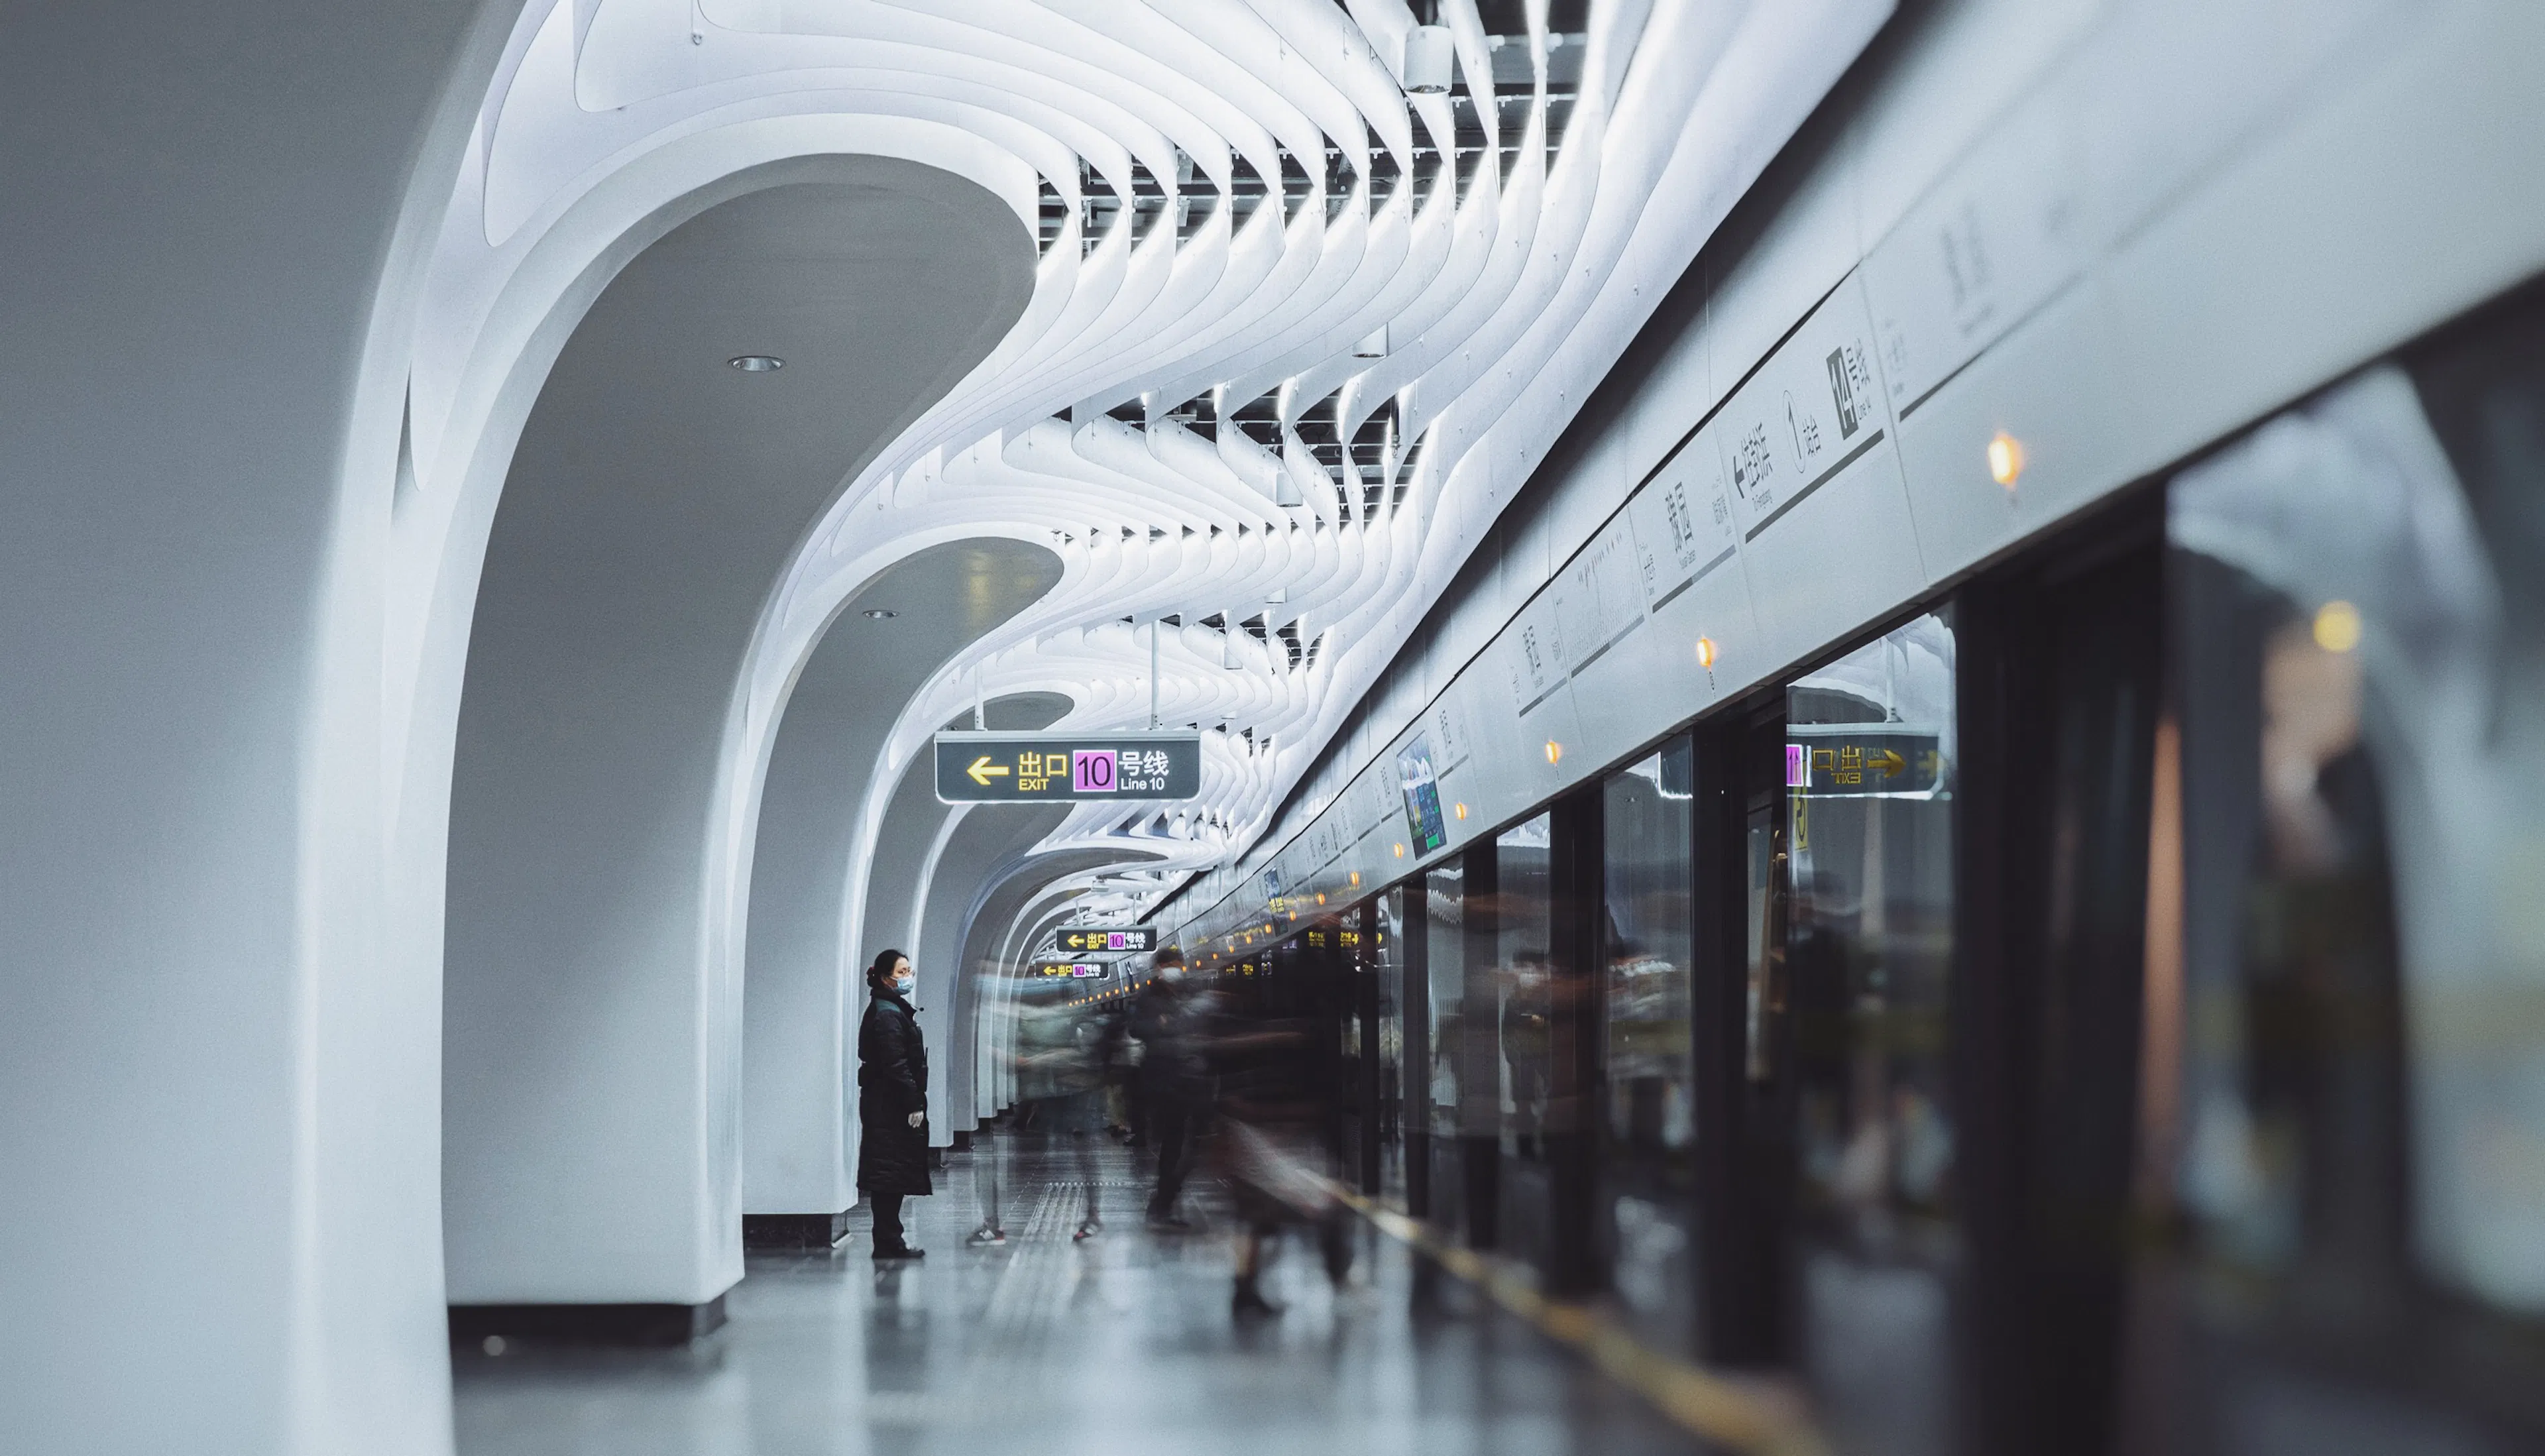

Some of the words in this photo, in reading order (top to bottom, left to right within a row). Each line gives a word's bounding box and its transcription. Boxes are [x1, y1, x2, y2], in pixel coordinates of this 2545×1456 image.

[1831, 357, 1854, 429] 14
[1788, 400, 1801, 460] 1
[1018, 751, 1068, 777] 出口
[1078, 756, 1111, 787] 10
[1118, 750, 1170, 777] 号线
[1018, 778, 1049, 791] EXIT
[1121, 778, 1147, 791] Line
[1149, 777, 1165, 791] 10
[1087, 932, 1107, 944] 出口
[1109, 934, 1123, 947] 10
[1126, 932, 1146, 944] 号线
[1074, 966, 1085, 976] 10
